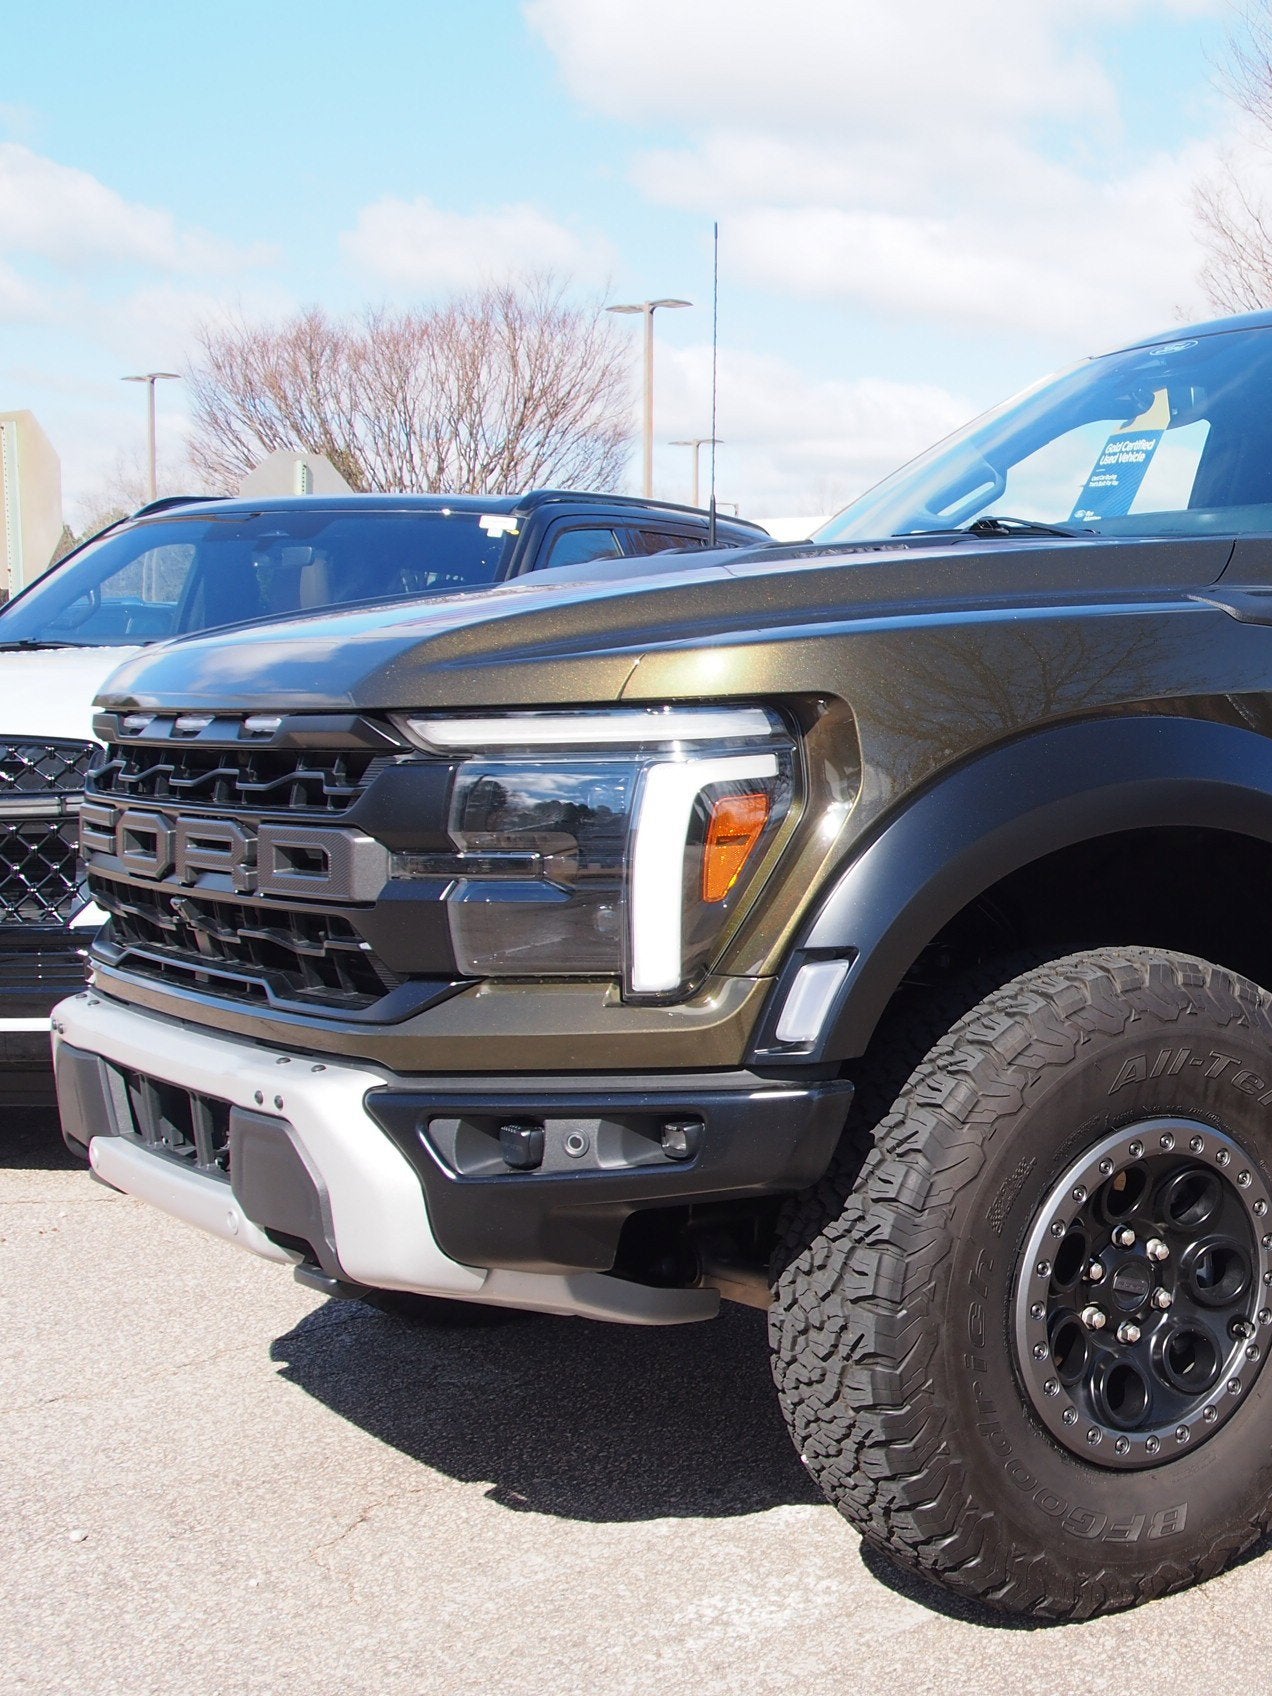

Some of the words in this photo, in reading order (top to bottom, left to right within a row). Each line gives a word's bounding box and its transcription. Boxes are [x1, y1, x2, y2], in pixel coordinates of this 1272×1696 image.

[1099, 453, 1119, 465] Used
[1118, 450, 1146, 463] Vehicle
[1105, 442, 1123, 453] Gold
[1122, 438, 1156, 451] Certified
[79, 802, 358, 902] FORD
[965, 1247, 1190, 1543] BFGoodrich
